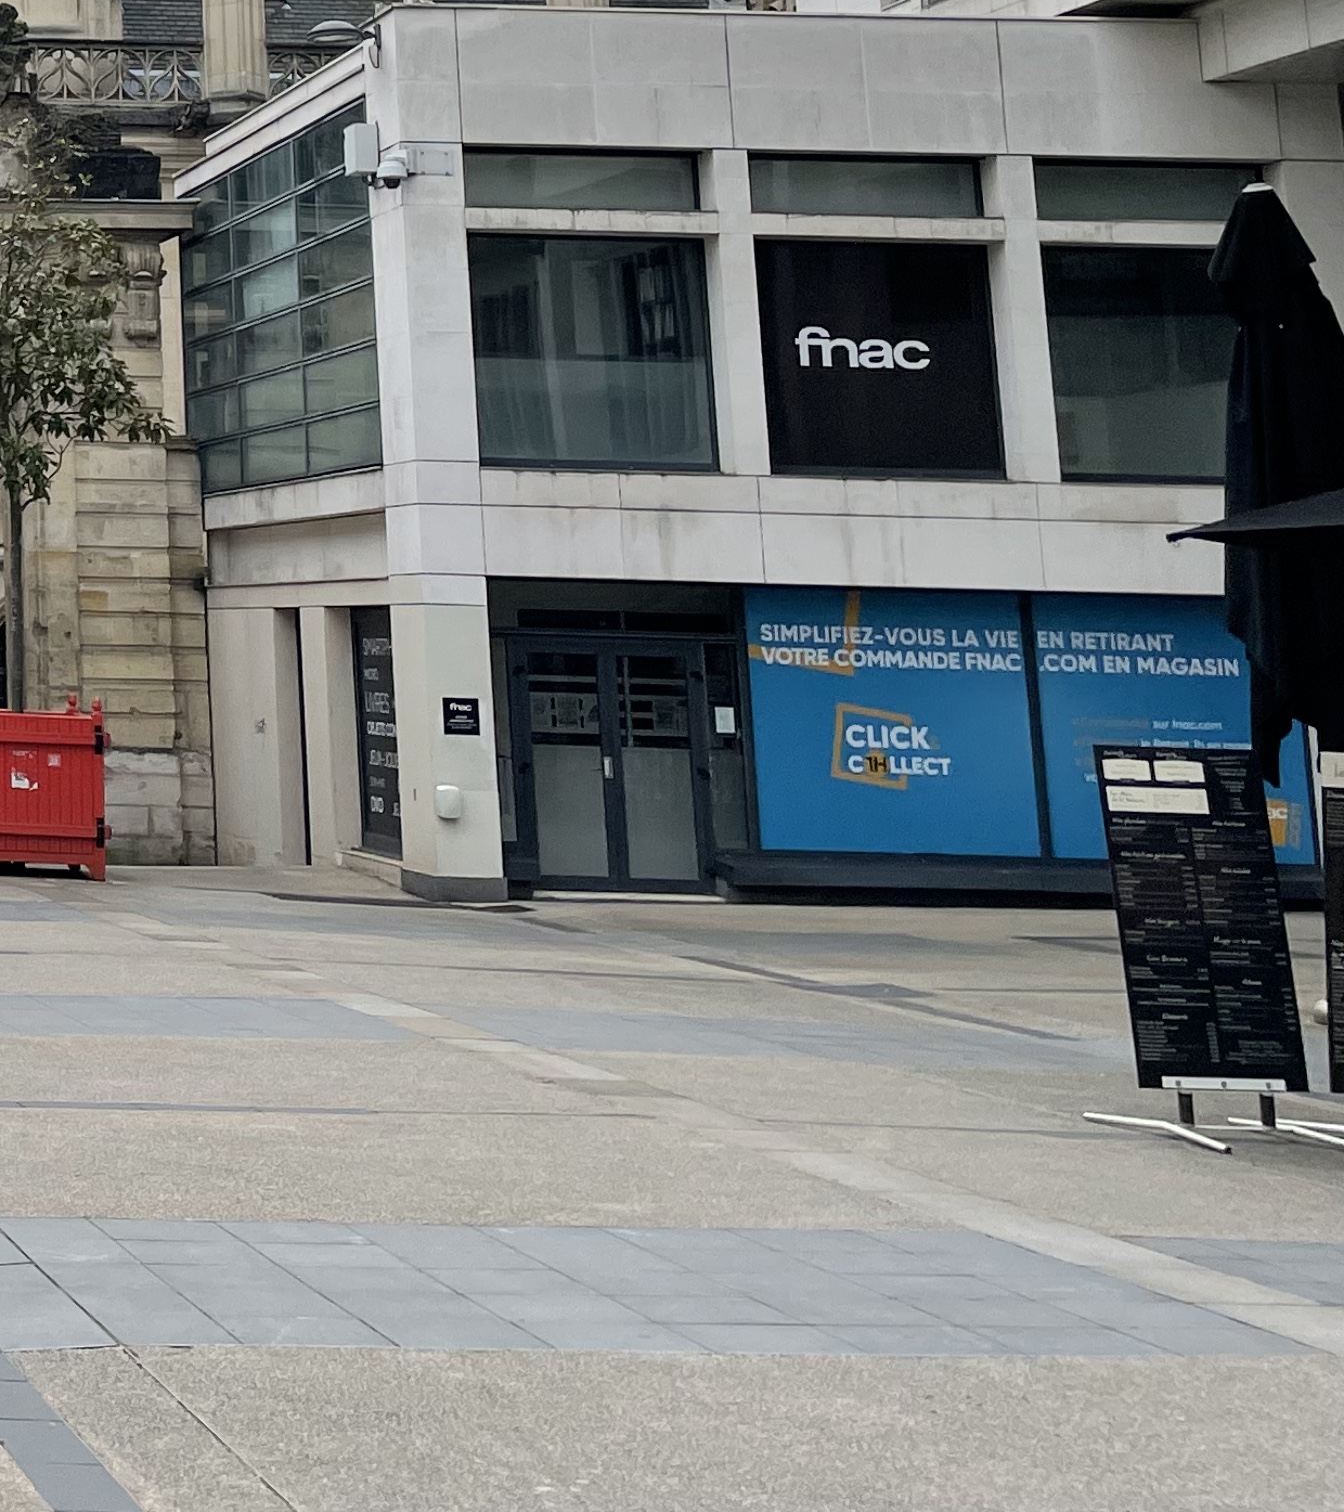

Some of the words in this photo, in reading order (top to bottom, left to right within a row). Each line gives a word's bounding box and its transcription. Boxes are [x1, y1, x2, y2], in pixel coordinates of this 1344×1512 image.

[795, 326, 931, 370] fnac
[760, 624, 946, 646] SIMPLIFIEZ-VOUS
[951, 630, 976, 647] LA
[984, 630, 1018, 649] VIE
[1037, 630, 1064, 649] EN
[1070, 631, 1175, 652] RETIRANT
[761, 646, 829, 667] VOTRE
[833, 649, 961, 670] COMMANDE
[1103, 655, 1130, 674] EN
[1136, 657, 1240, 677] MAGASIN
[845, 724, 930, 750] CLICK
